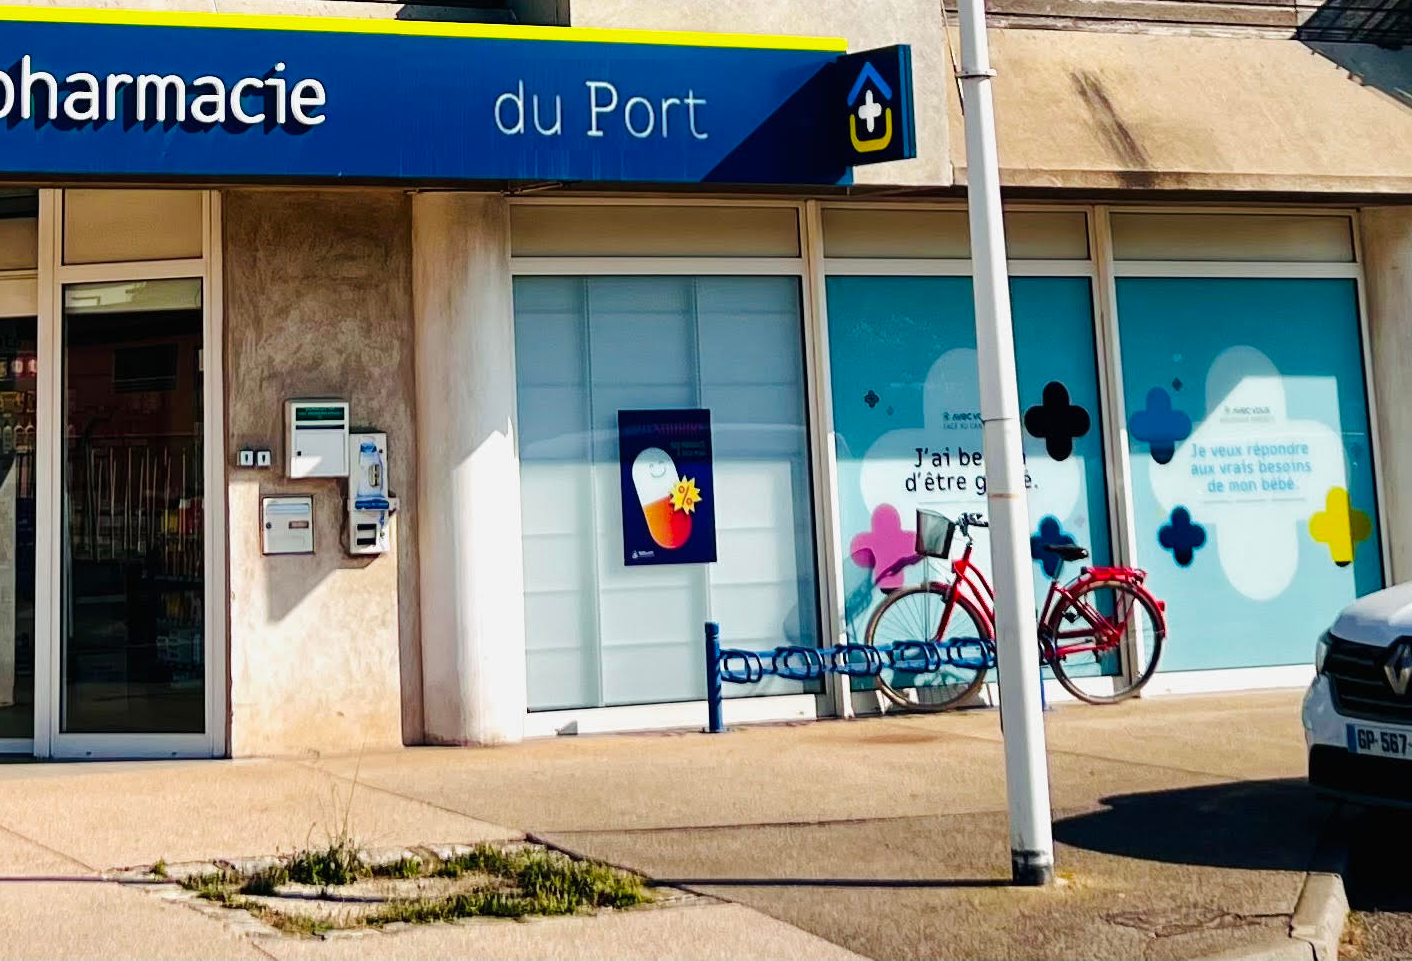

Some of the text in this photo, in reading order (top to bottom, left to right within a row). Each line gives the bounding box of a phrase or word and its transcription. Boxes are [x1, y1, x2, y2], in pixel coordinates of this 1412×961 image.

[494, 78, 709, 139] du Port
[914, 446, 950, 468] J'ai
[1191, 442, 1309, 459] Je veux répondre
[1191, 459, 1313, 476] aux vrais besoins
[905, 471, 967, 492] d'être
[1207, 478, 1225, 493] de
[1228, 480, 1258, 492] mon
